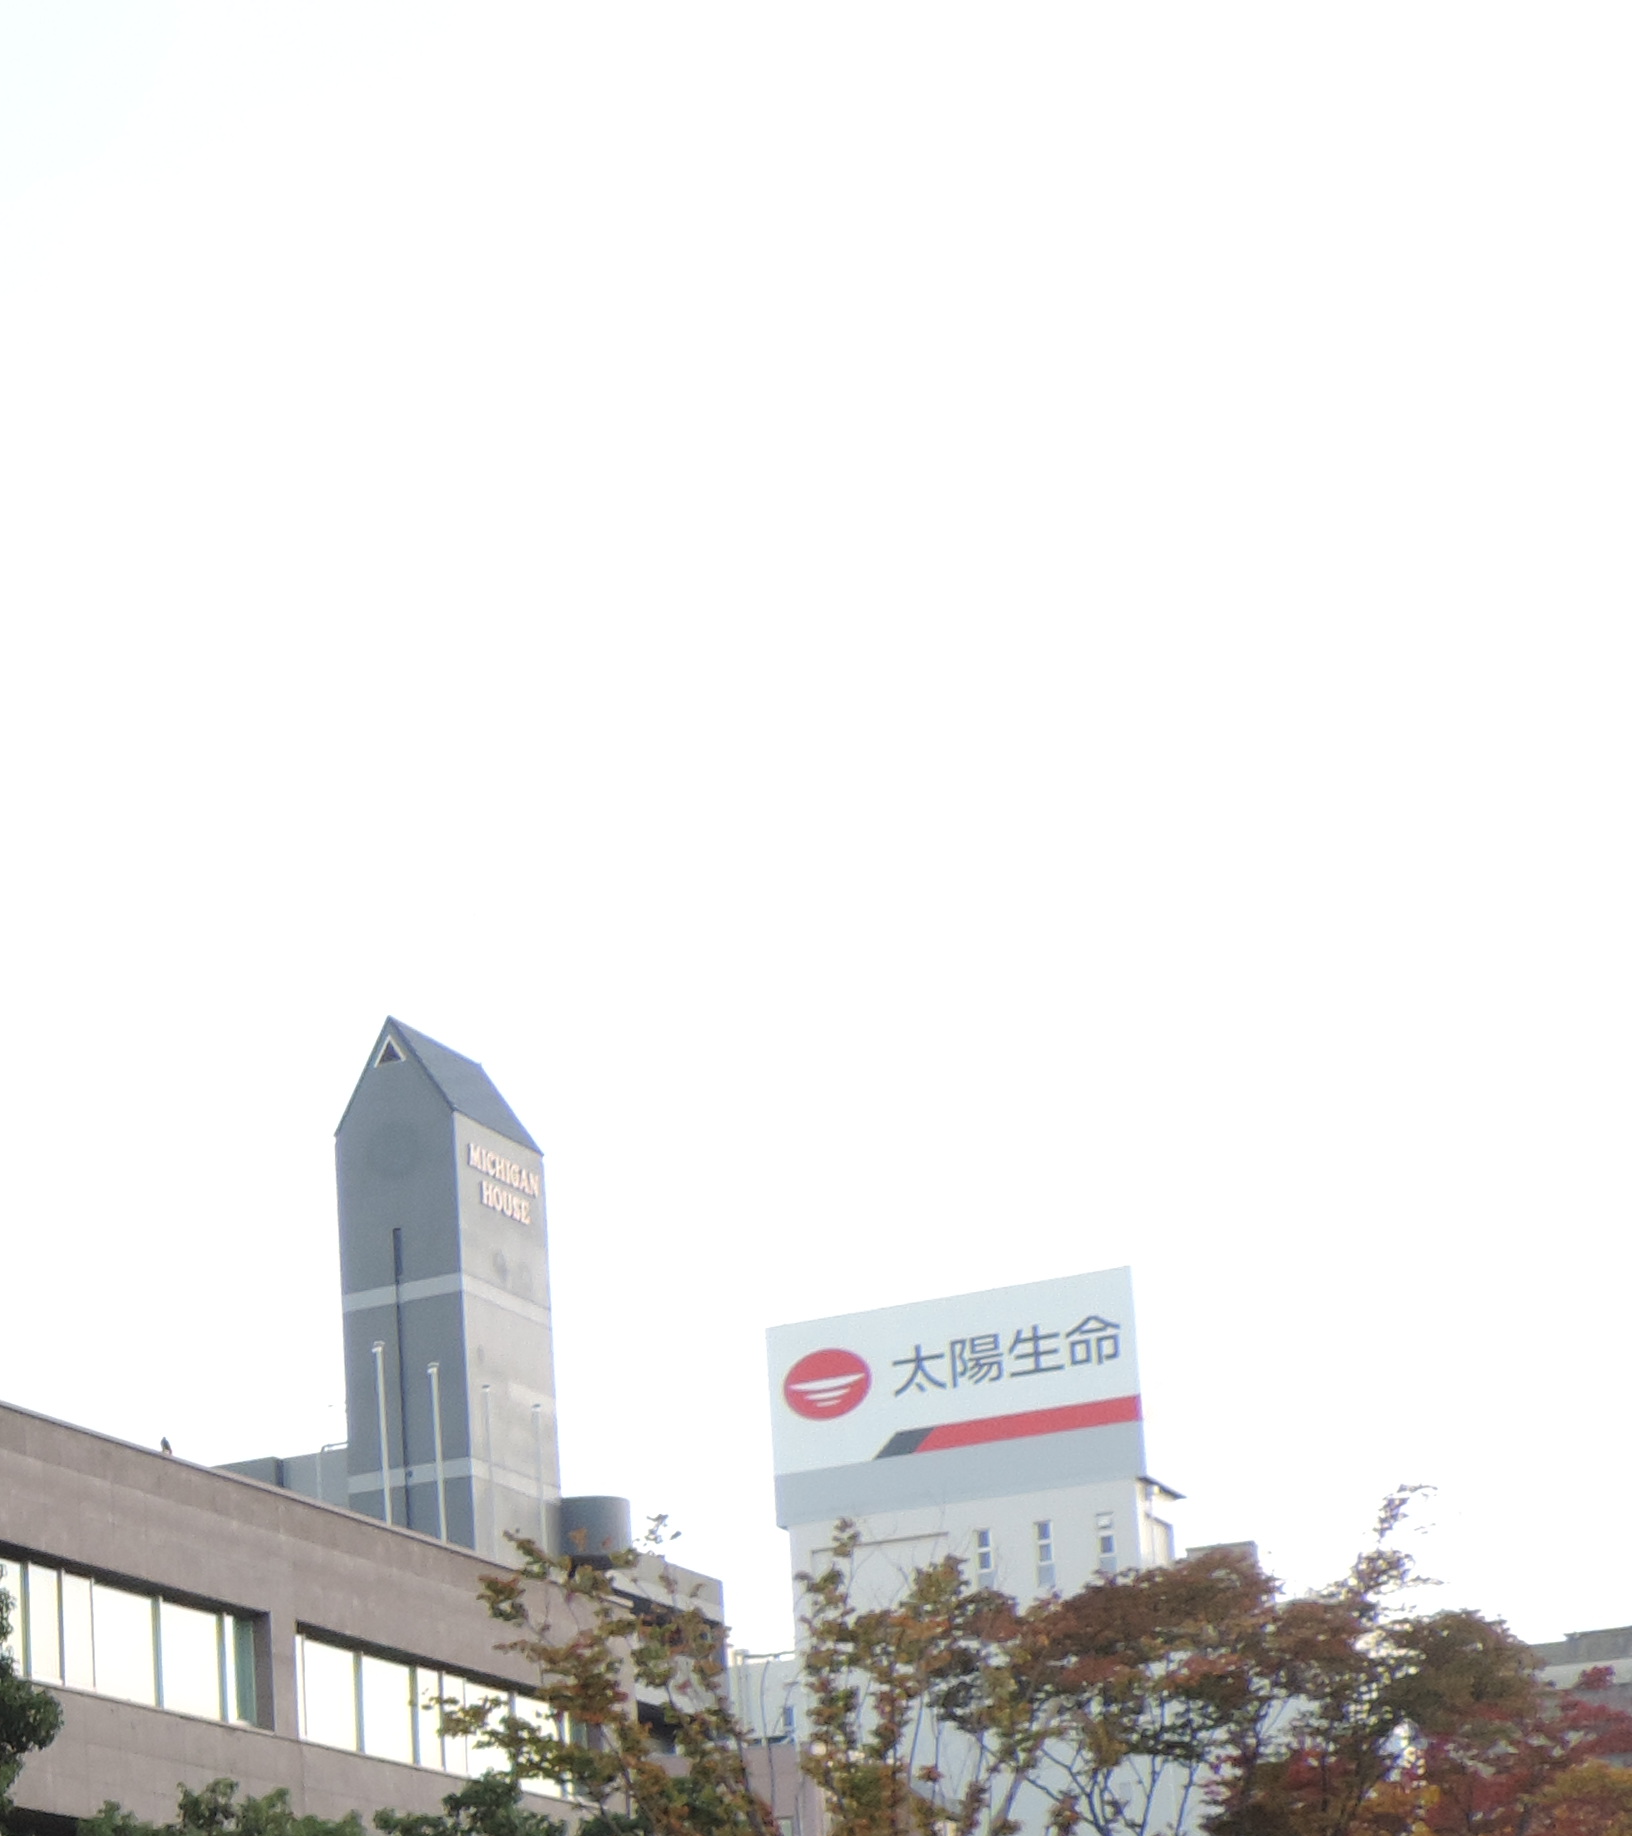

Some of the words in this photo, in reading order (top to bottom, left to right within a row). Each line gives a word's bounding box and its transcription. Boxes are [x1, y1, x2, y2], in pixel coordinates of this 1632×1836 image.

[466, 1143, 540, 1199] MICHIGAN
[479, 1180, 533, 1225] HOUSE
[892, 1315, 1121, 1397] 太陽生命
